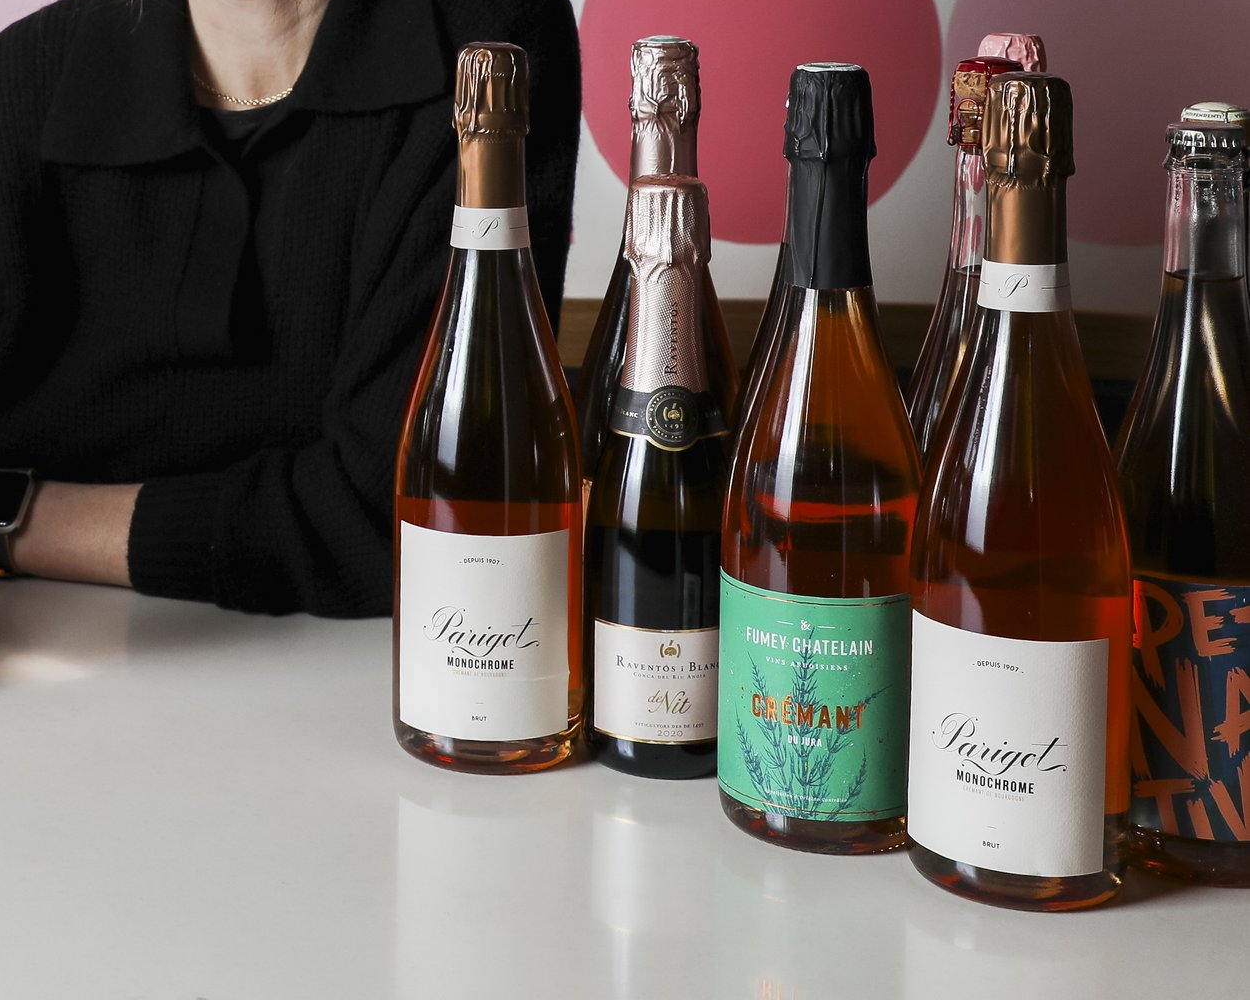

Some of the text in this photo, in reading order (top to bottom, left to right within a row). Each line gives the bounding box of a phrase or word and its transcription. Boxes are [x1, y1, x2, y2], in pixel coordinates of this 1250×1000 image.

[471, 216, 500, 239] P
[998, 273, 1031, 299] P
[423, 606, 540, 658] Parigot
[746, 626, 873, 656] FUMEY CHATELAIN
[447, 656, 515, 670] MONOCHROME
[765, 656, 786, 666] VINS
[977, 660, 1019, 673] DEPUIS 1907
[648, 690, 693, 715] Nit
[752, 693, 867, 729] CRÉMANT
[787, 734, 822, 747] DU JURA
[931, 712, 1069, 776] Parigot
[956, 769, 1035, 794] MONOCHROME
[982, 840, 1000, 849] BRUT
